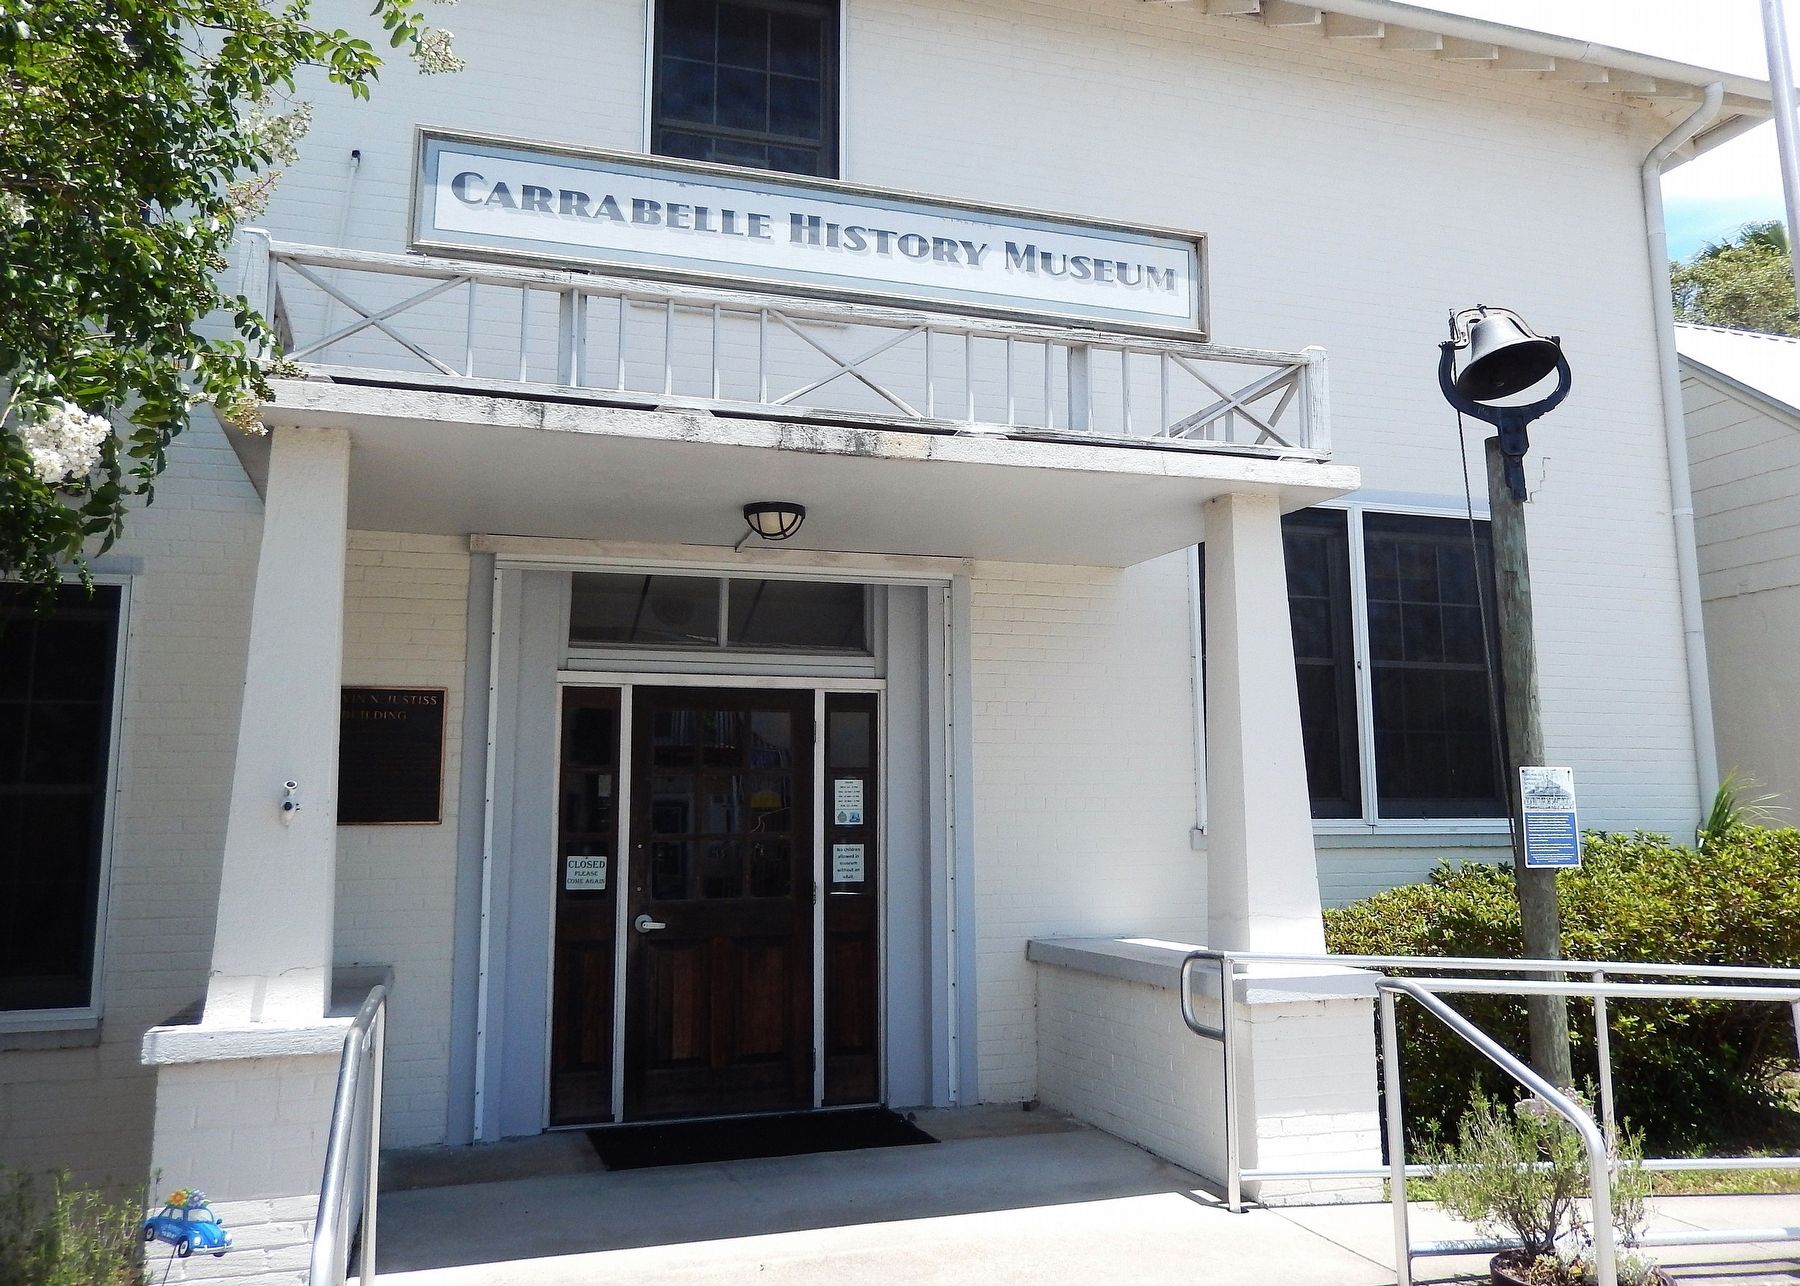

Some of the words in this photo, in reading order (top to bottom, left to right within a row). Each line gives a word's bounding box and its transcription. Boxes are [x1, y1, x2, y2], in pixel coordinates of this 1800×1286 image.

[451, 171, 775, 239] CARRABELLE
[789, 212, 988, 266] HISTORY
[1004, 241, 1177, 291] MUSEUM
[568, 860, 605, 869] CLOSED
